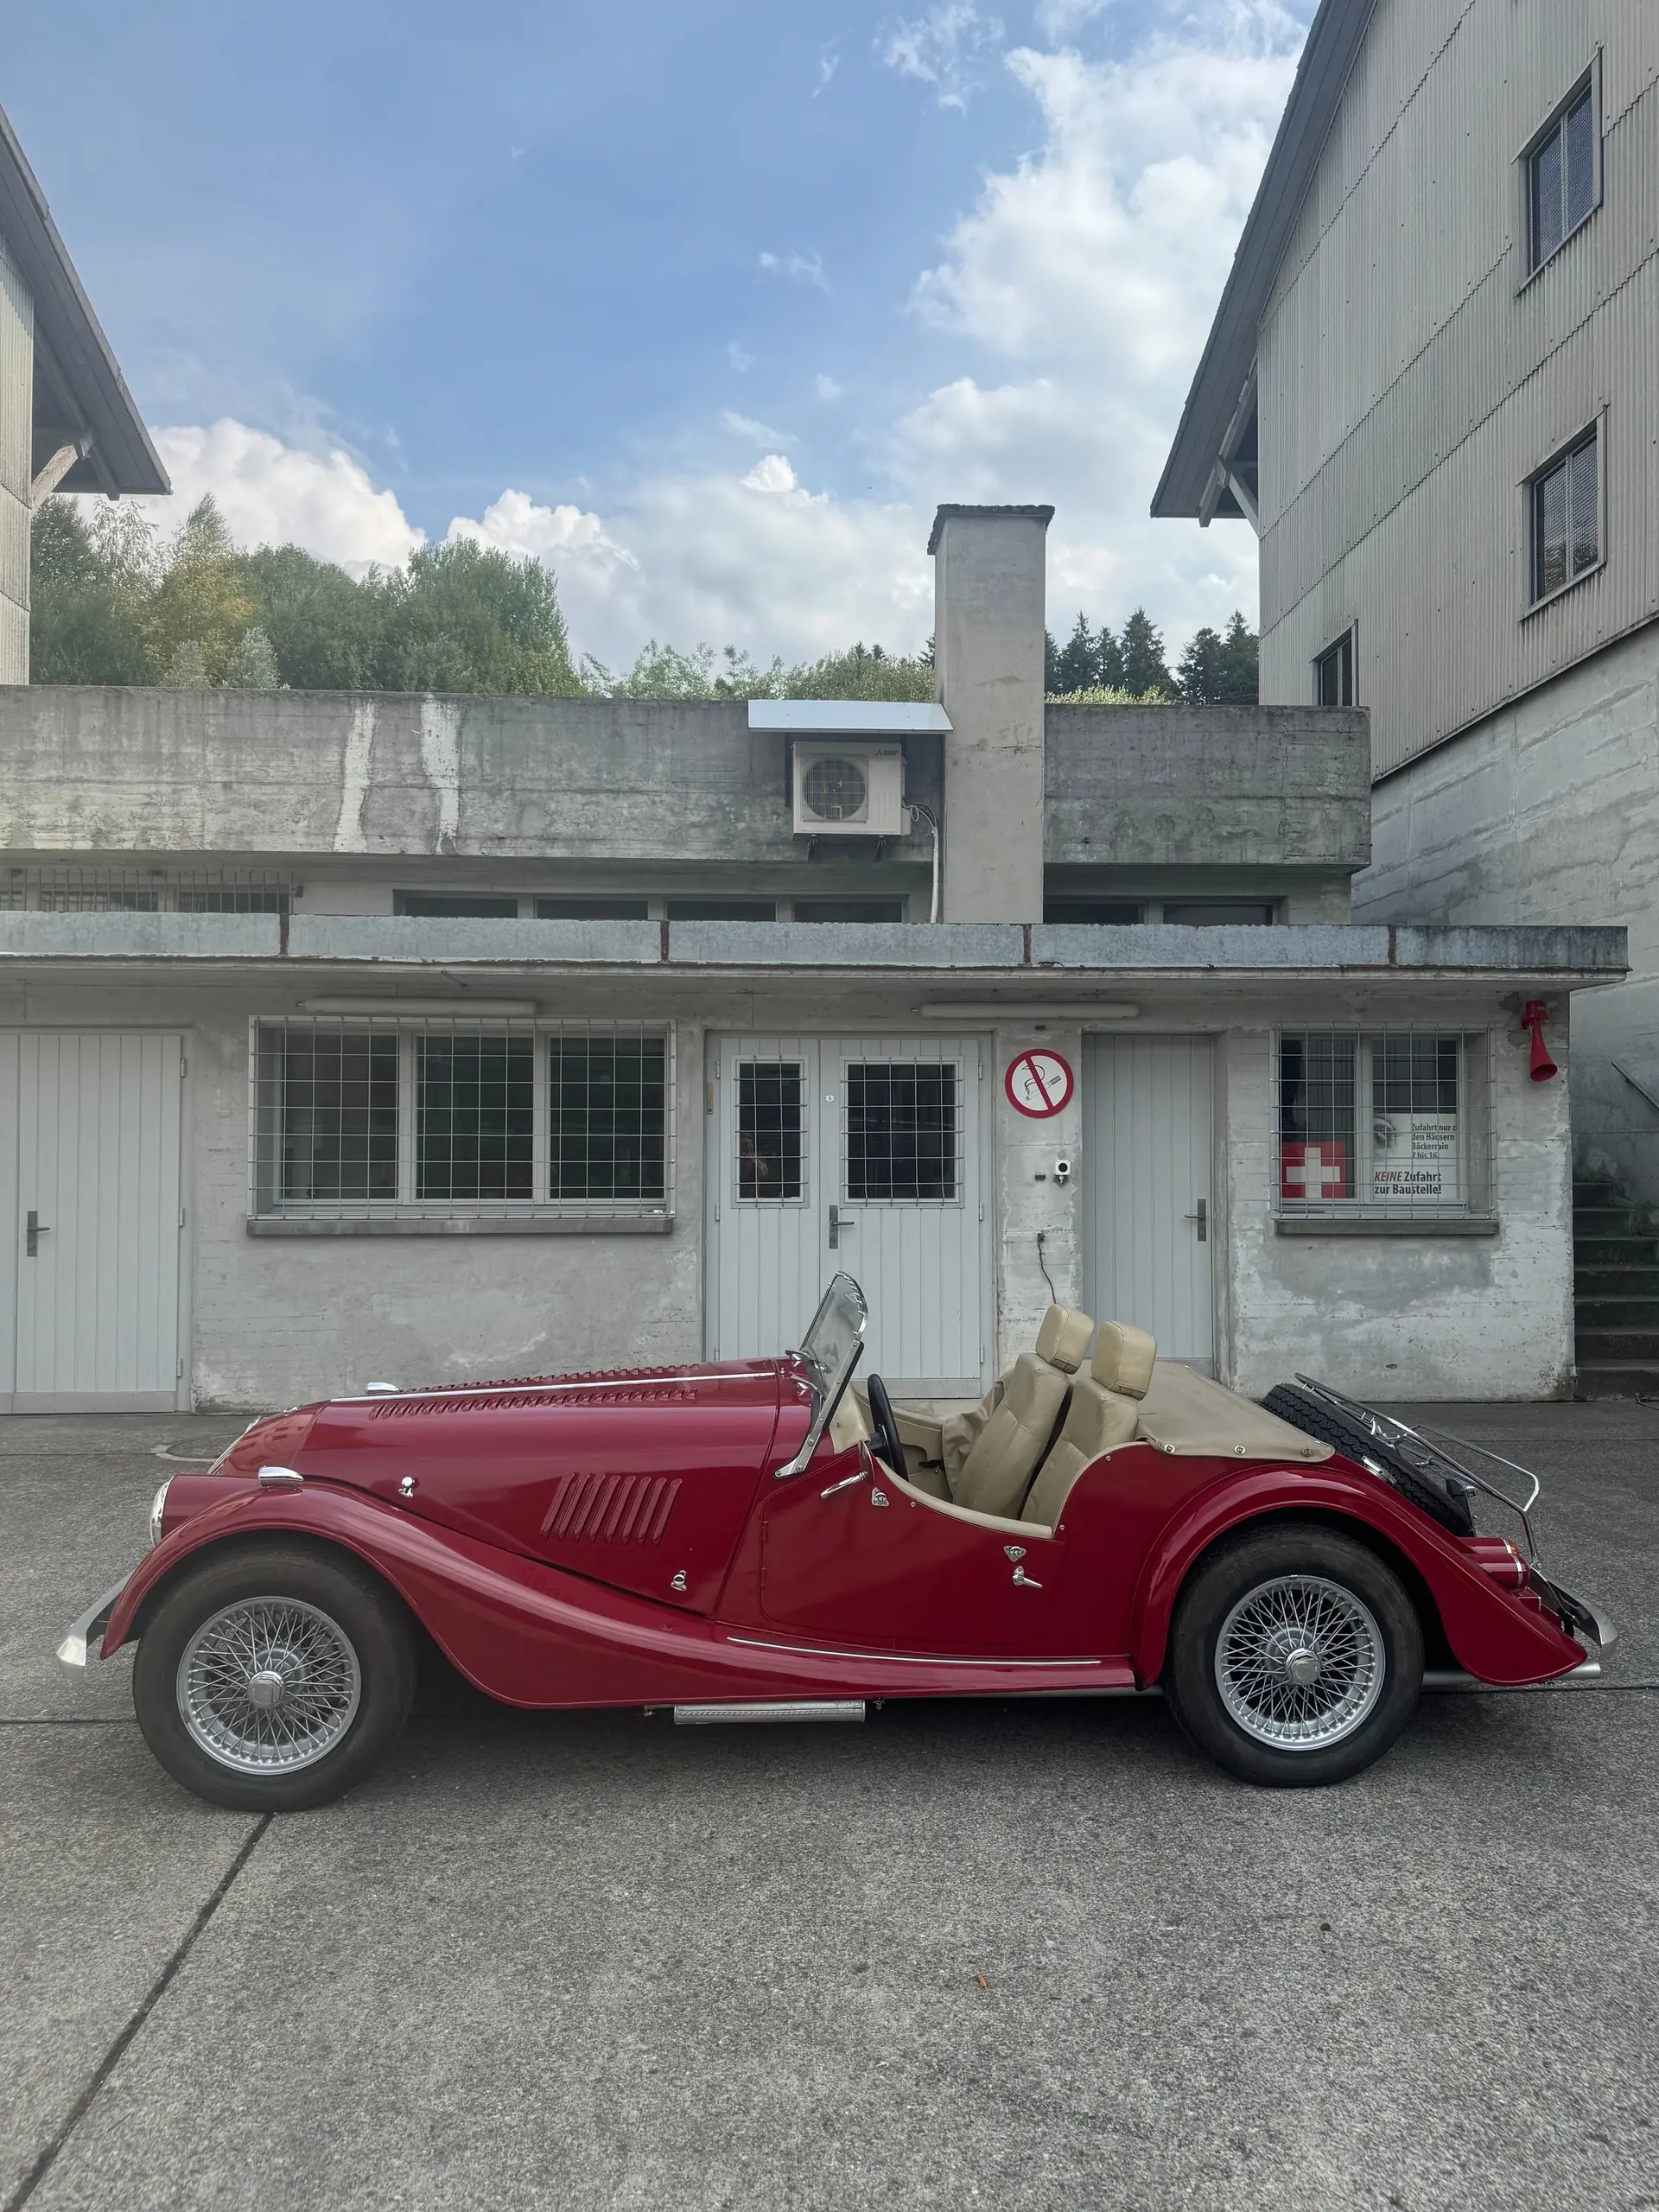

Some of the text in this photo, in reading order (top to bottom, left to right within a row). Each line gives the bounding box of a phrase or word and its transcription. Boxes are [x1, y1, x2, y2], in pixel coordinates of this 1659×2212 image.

[1374, 1171, 1441, 1182] KEINE Zufahrt
[1374, 1184, 1442, 1195] zur Baustelle!
